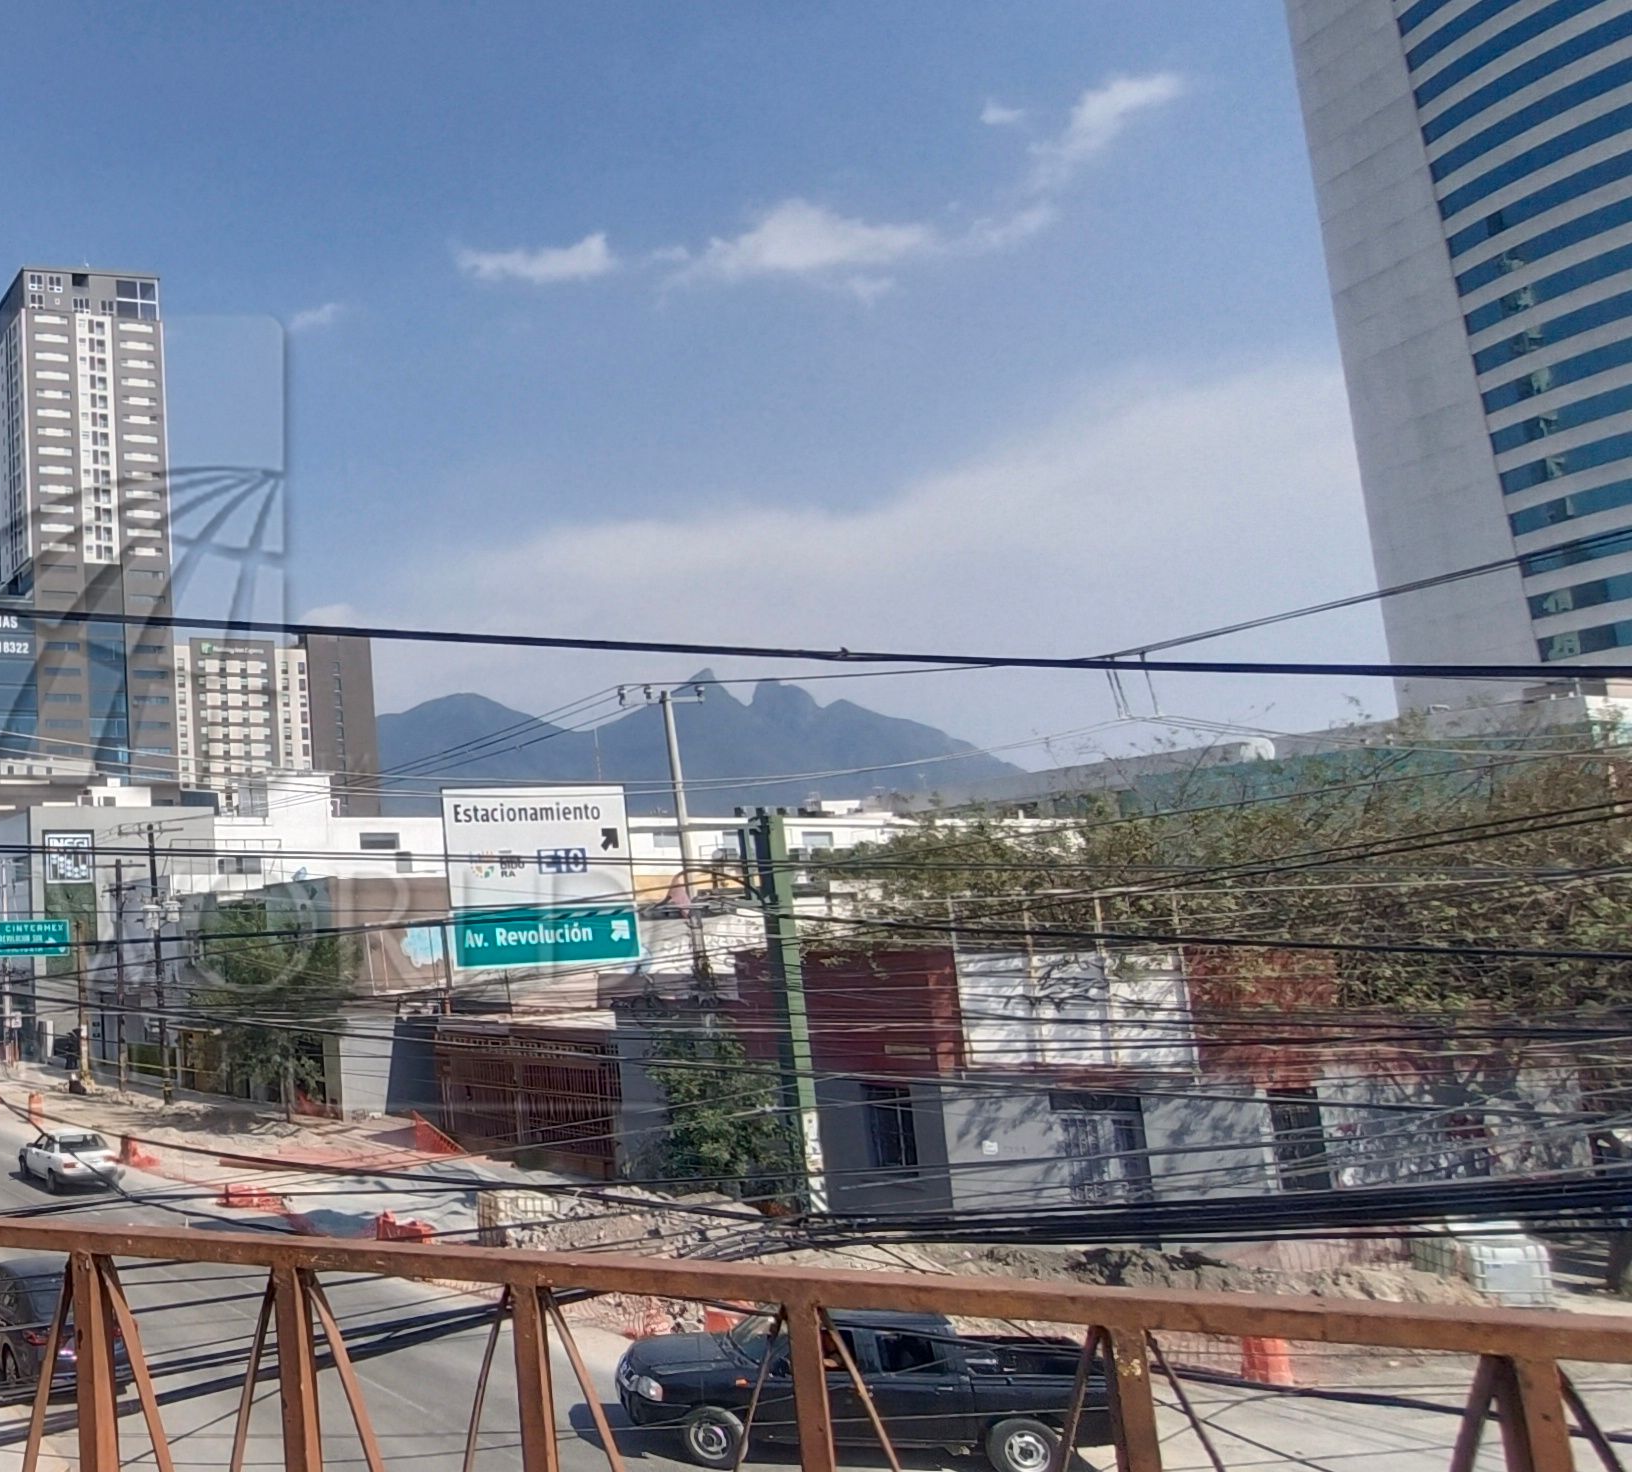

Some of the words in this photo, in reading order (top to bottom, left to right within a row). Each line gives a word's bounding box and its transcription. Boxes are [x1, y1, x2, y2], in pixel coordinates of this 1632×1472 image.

[453, 802, 601, 824] Estacionamiento
[540, 849, 584, 873] E10
[501, 870, 516, 878] RA
[5, 923, 64, 933] CINTERMEX
[465, 928, 489, 948] Av.
[496, 923, 593, 947] Revolución
